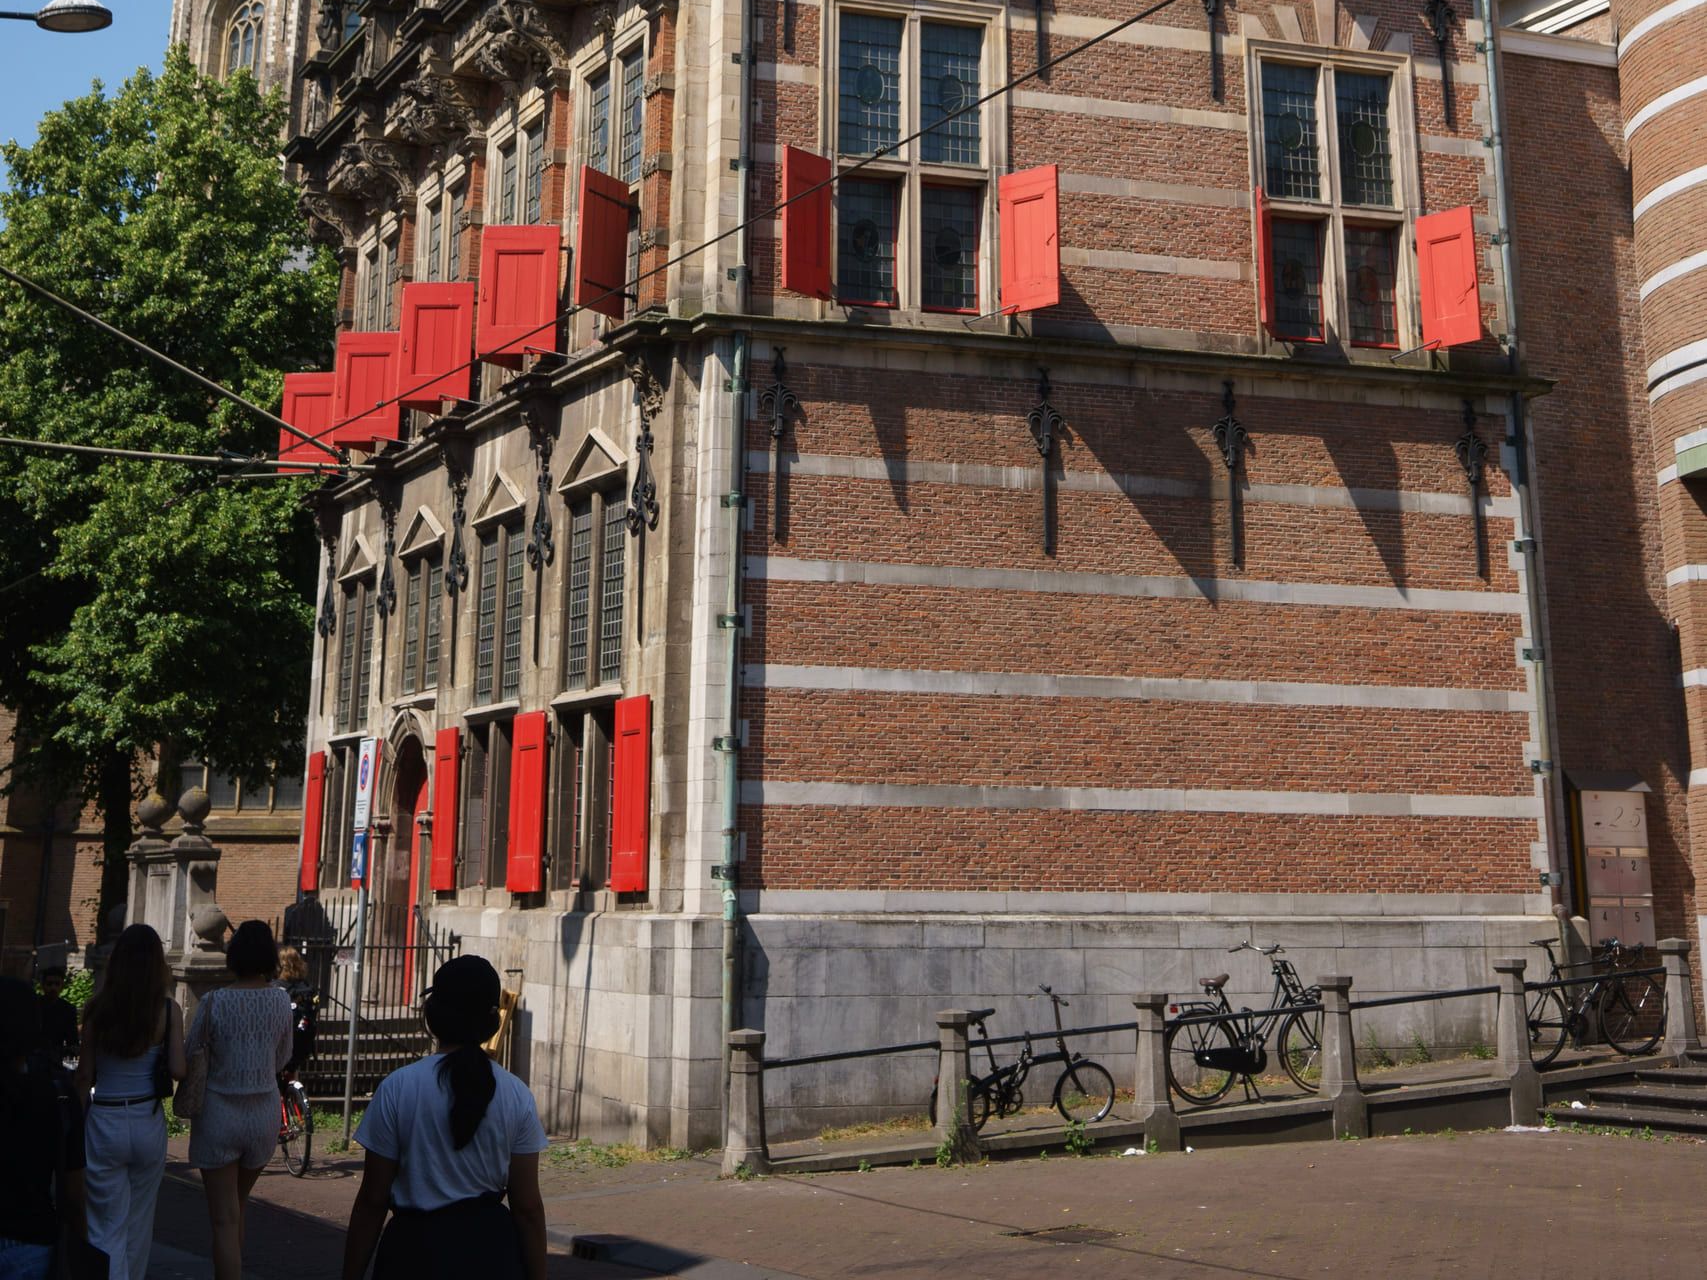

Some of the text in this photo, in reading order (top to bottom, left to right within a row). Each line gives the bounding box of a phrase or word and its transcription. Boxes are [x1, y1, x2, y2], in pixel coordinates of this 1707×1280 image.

[1600, 858, 1606, 870] 3
[1631, 860, 1637, 871] 2
[1602, 911, 1608, 921] 4
[1634, 911, 1641, 923] 5
